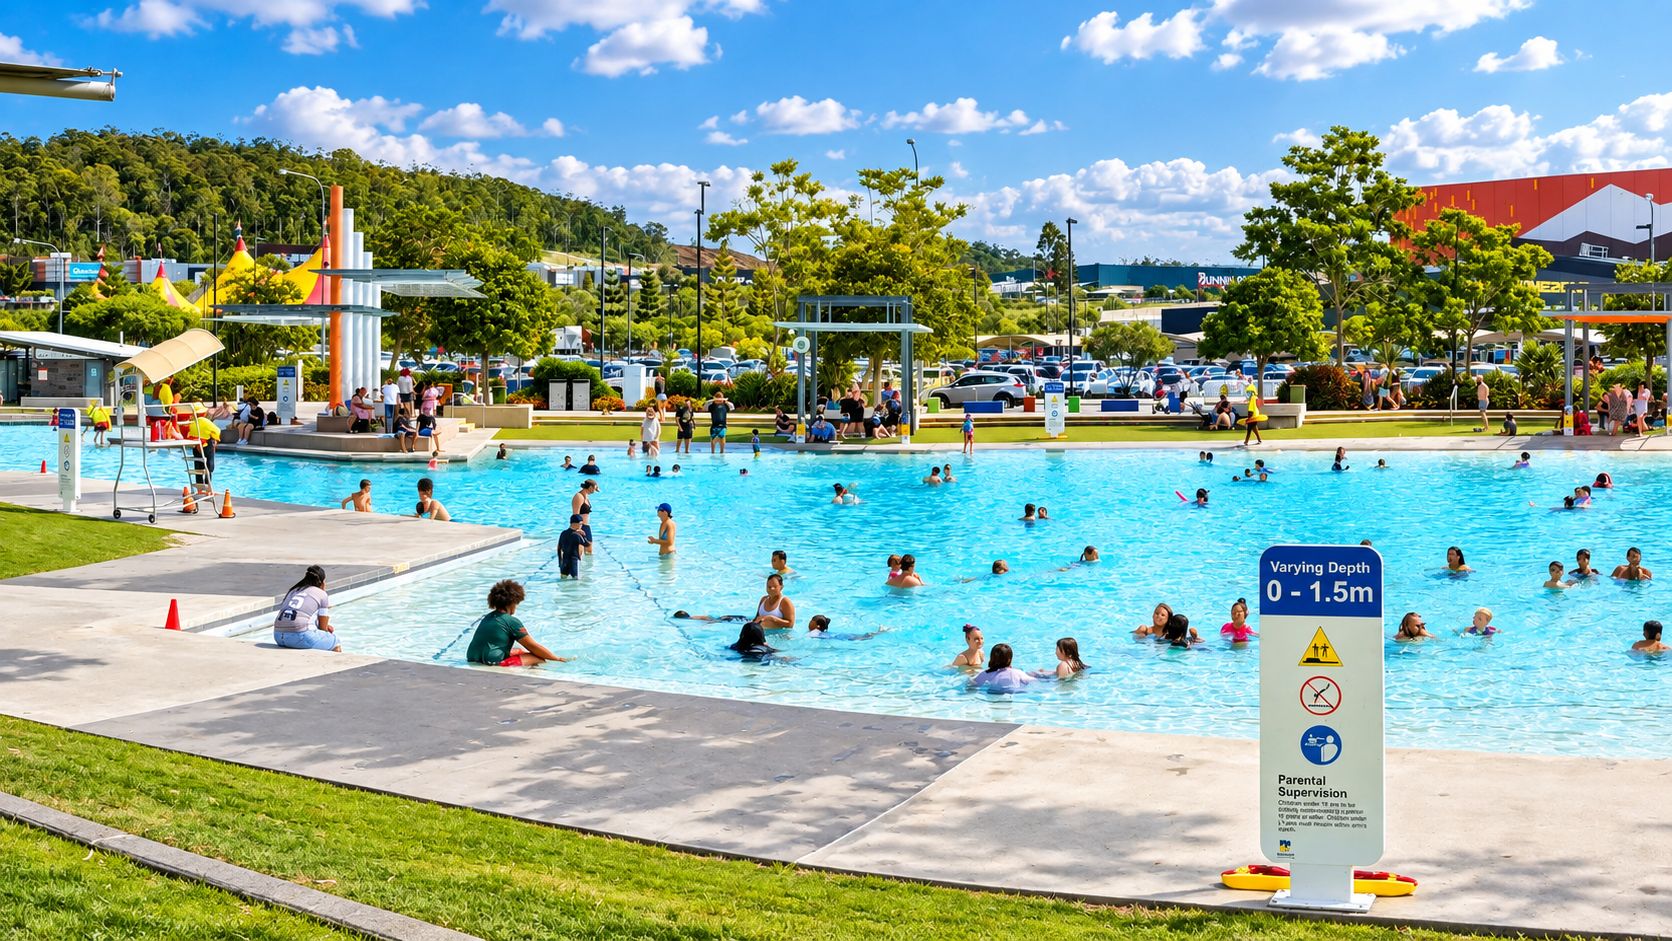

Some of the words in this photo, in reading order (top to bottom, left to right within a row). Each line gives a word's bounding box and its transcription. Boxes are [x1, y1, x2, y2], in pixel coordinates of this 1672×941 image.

[1270, 561, 1323, 576] Varying
[1328, 562, 1370, 576] Depth
[1267, 580, 1282, 602] 0
[1309, 580, 1373, 603] 1.5m
[1278, 774, 1326, 786] Parental
[1278, 786, 1348, 799] Supervision
